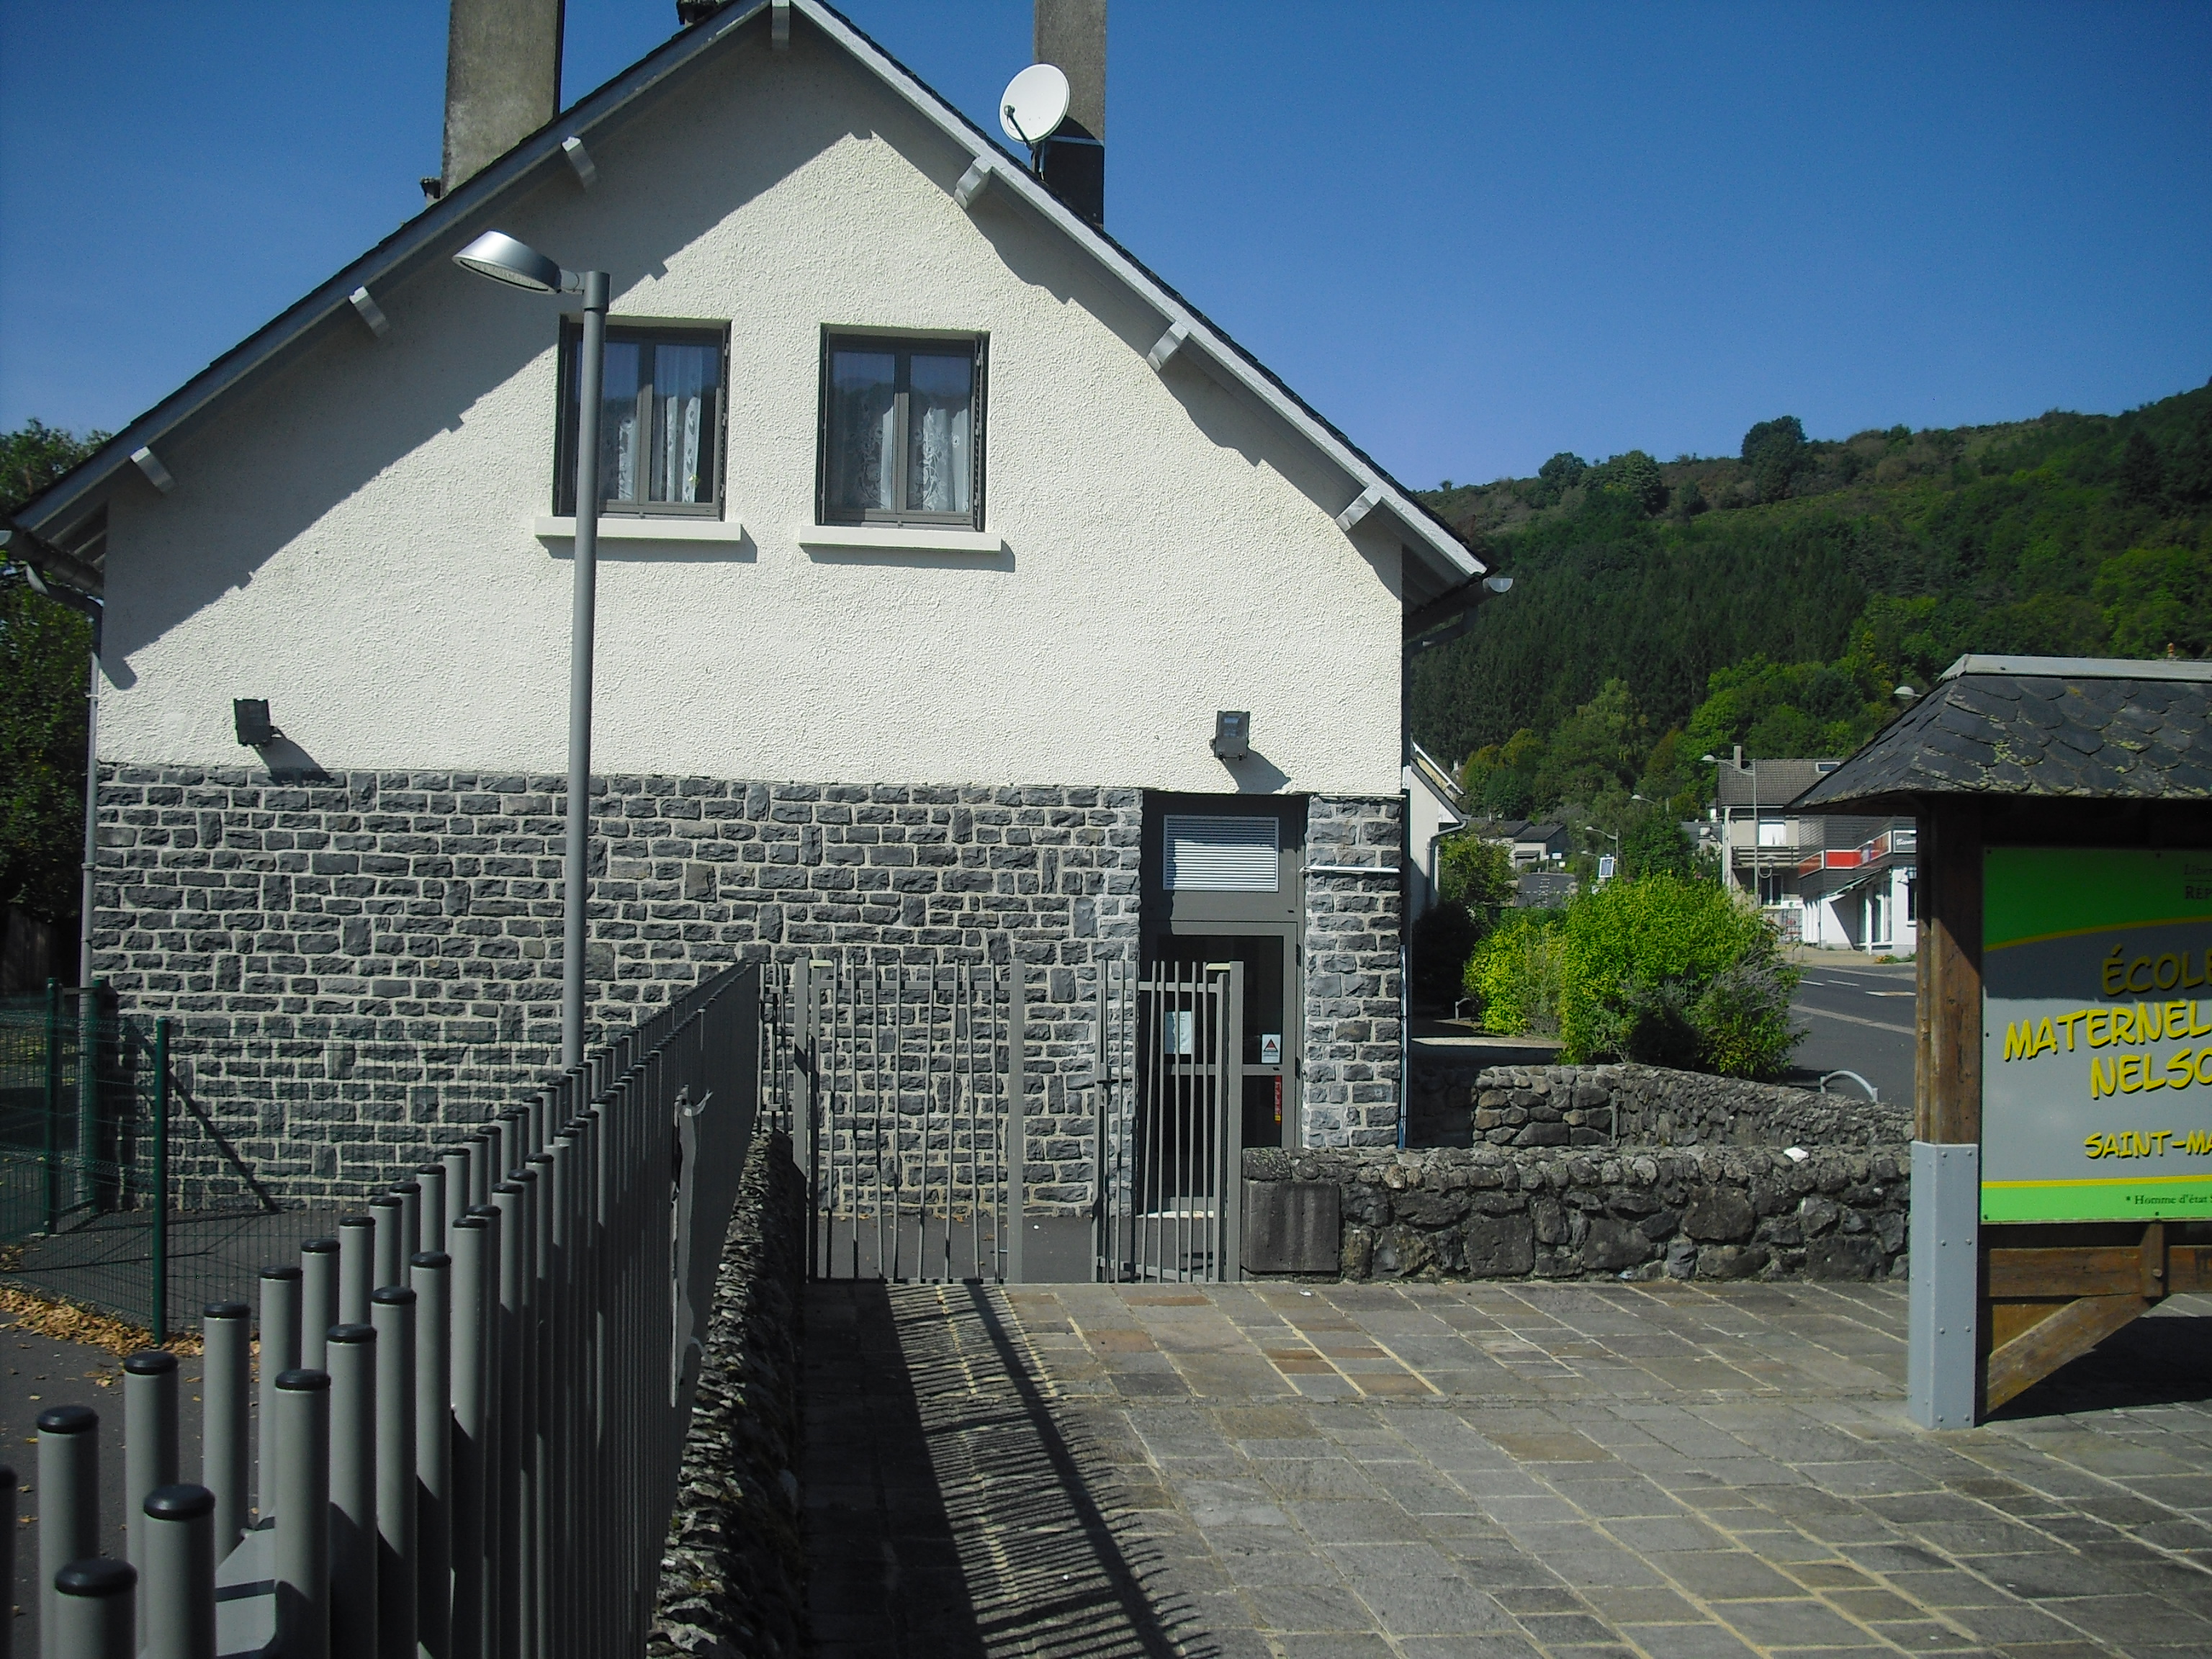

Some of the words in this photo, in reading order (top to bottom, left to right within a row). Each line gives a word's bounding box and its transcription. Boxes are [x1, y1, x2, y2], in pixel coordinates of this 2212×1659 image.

[2004, 999, 2212, 1062] MATERNEL
[2135, 1195, 2176, 1205] Homme
[2179, 1194, 2207, 1204] d'état
